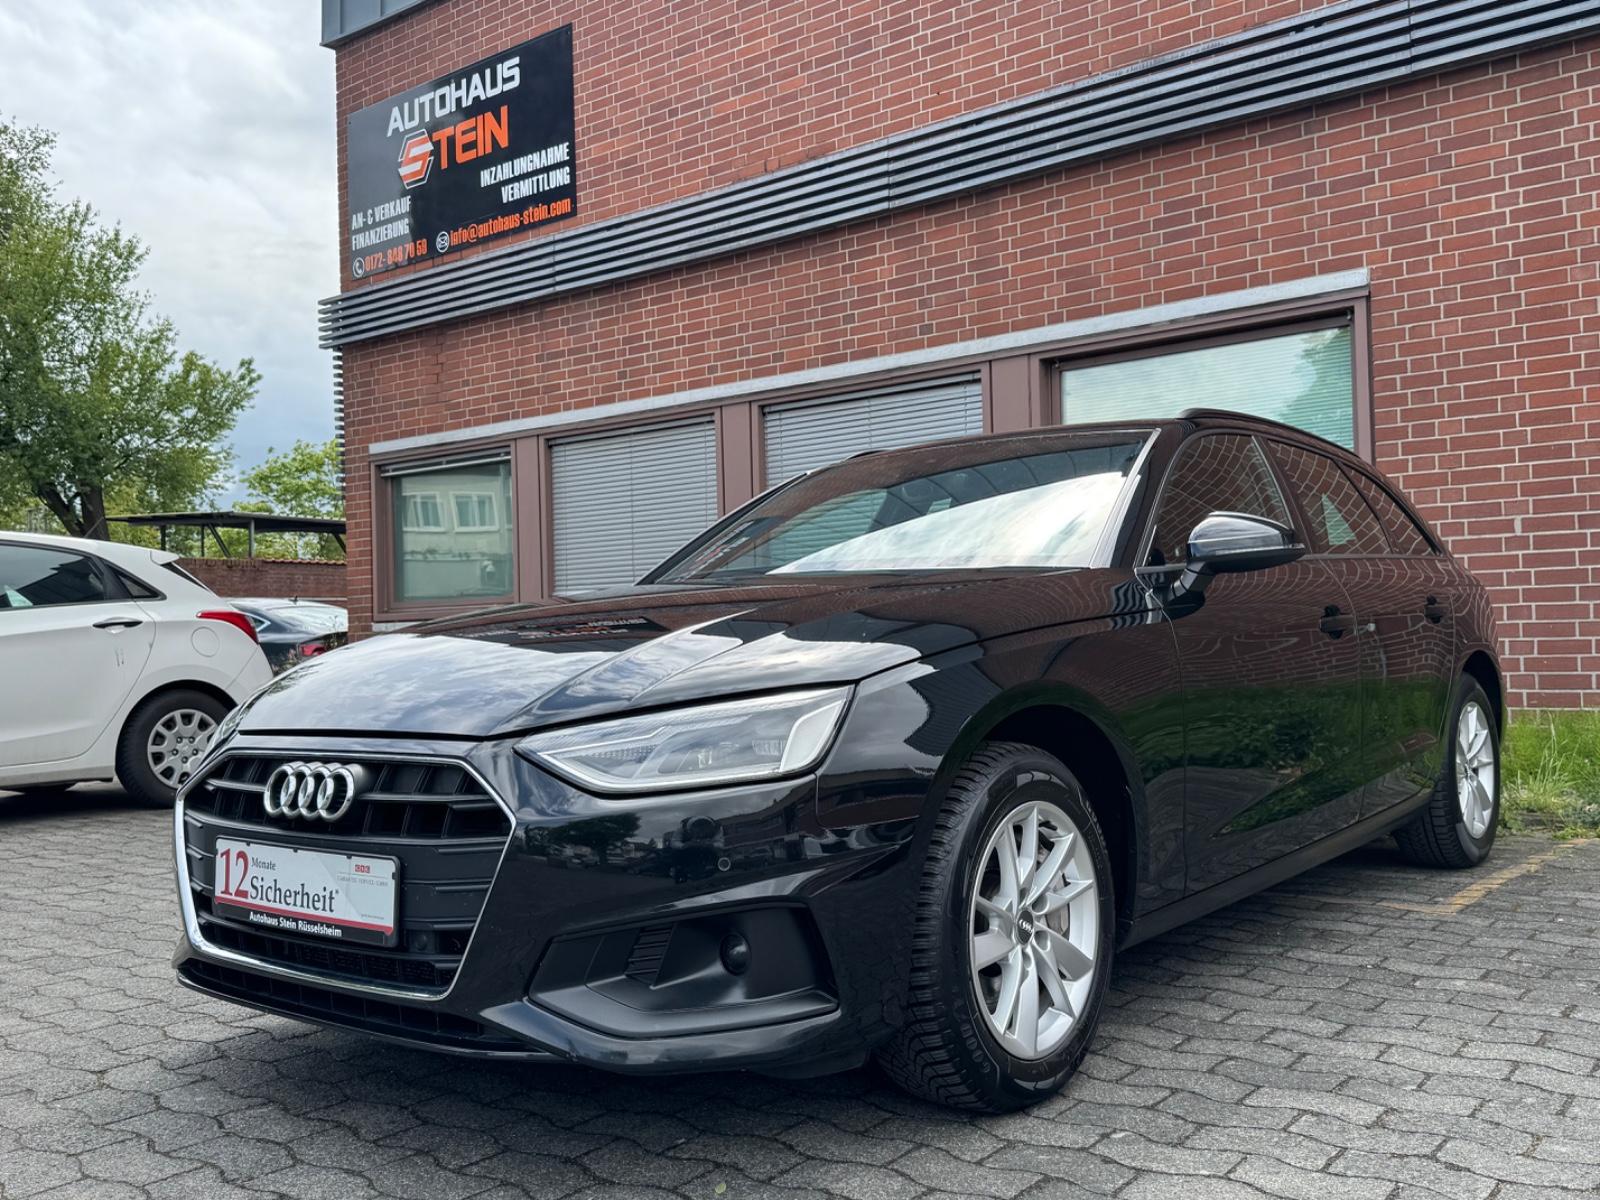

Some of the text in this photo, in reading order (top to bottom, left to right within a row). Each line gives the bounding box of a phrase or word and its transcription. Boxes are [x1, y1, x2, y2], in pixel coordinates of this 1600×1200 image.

[386, 56, 521, 138] AUTOHAUS
[399, 104, 509, 187] STEIN
[480, 141, 570, 188] INZAHLUNGNAHME
[501, 165, 571, 204] VERMITTLUNG
[374, 195, 411, 223] VERKAUF
[450, 198, 571, 246] info@autohaus-stein.com
[352, 218, 410, 251] FINANZIERUNG
[220, 848, 249, 900] 12
[251, 857, 277, 871] Monate
[249, 911, 343, 938] Autohaus Stein Rüsselsheim
